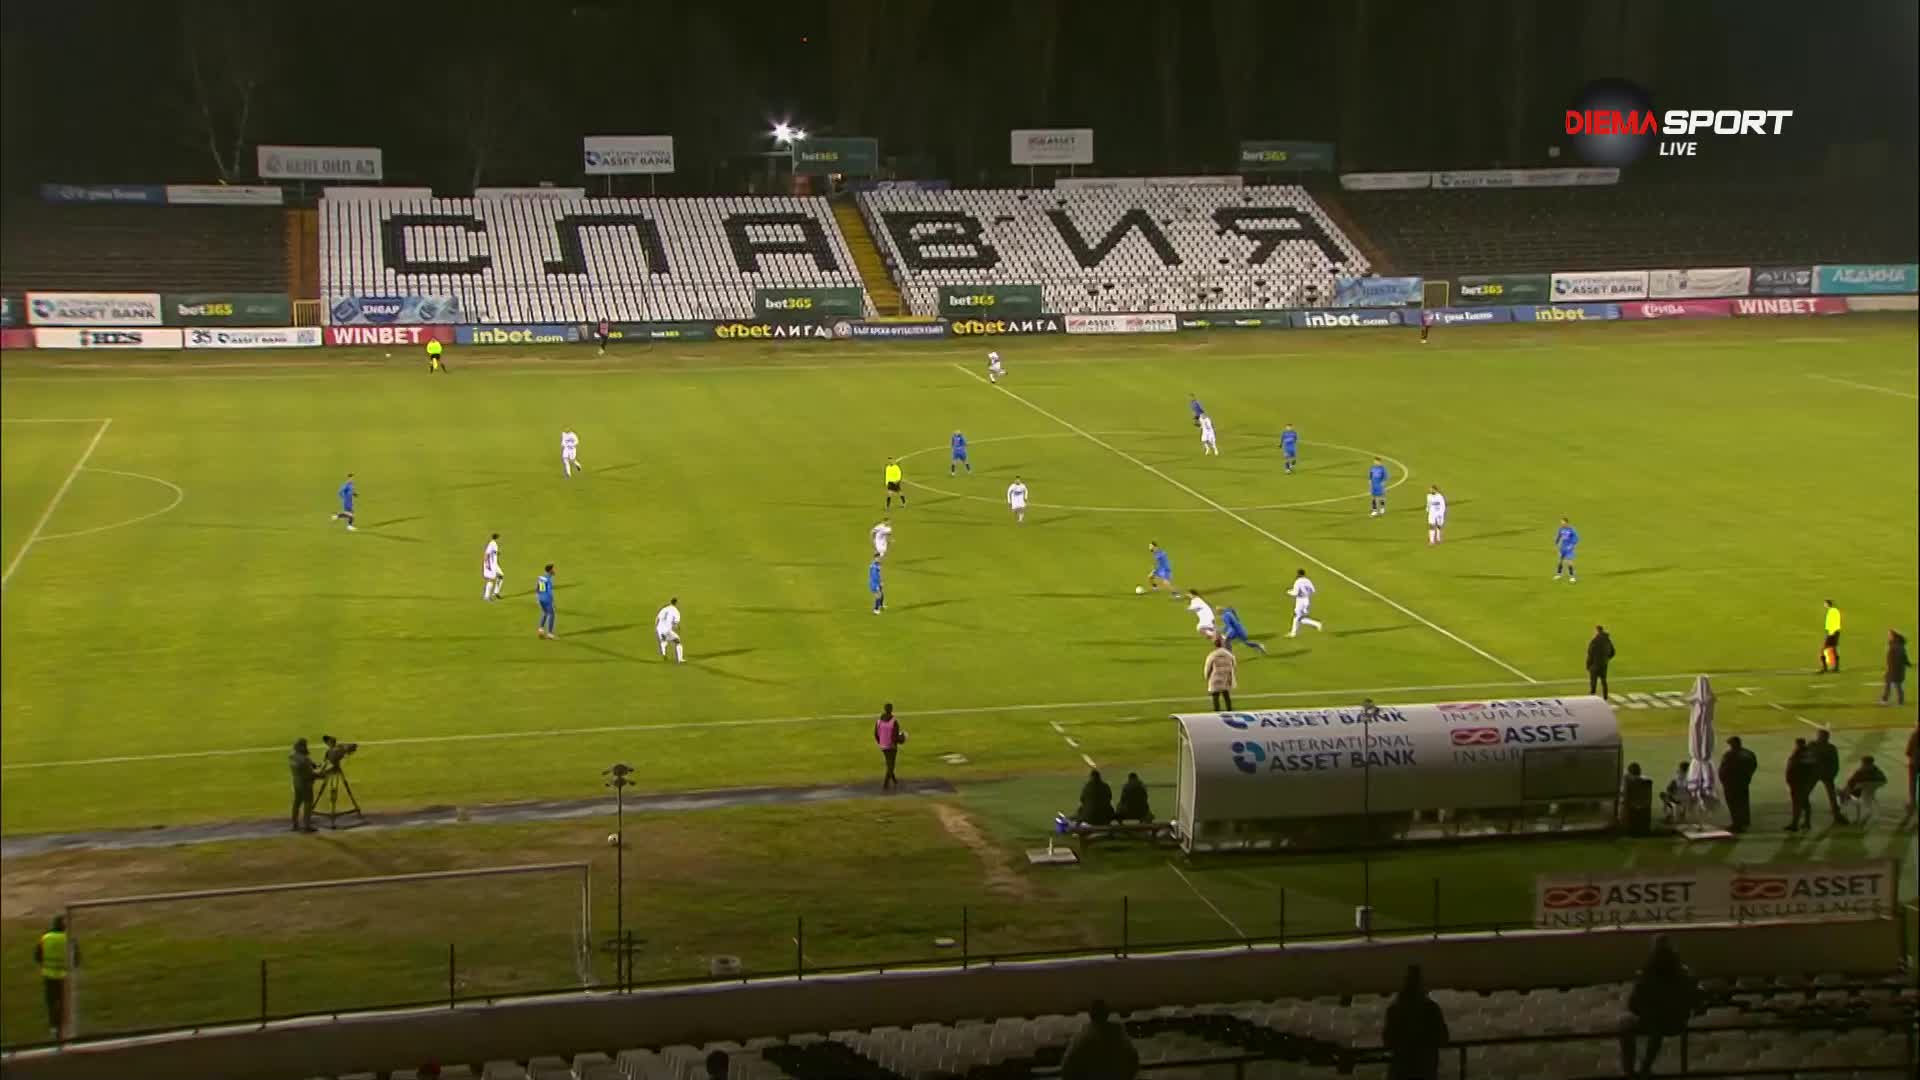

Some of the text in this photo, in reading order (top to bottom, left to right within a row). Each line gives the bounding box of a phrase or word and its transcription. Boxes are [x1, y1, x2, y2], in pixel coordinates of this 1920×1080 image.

[766, 298, 812, 309] bet365
[950, 295, 995, 306] bet365
[1739, 299, 1819, 314] WINBET
[178, 303, 233, 315] bet365
[715, 323, 773, 339] efbet
[951, 319, 1006, 335] efbet
[333, 327, 424, 344] WINBET
[1260, 714, 1331, 728] ASSET
[1503, 723, 1580, 744] ASSET
[1266, 734, 1416, 752] INTERNATIONAL
[1269, 748, 1417, 773] ASSET BANK
[1604, 881, 1696, 905] ASSET
[1790, 873, 1884, 898] ASSET
